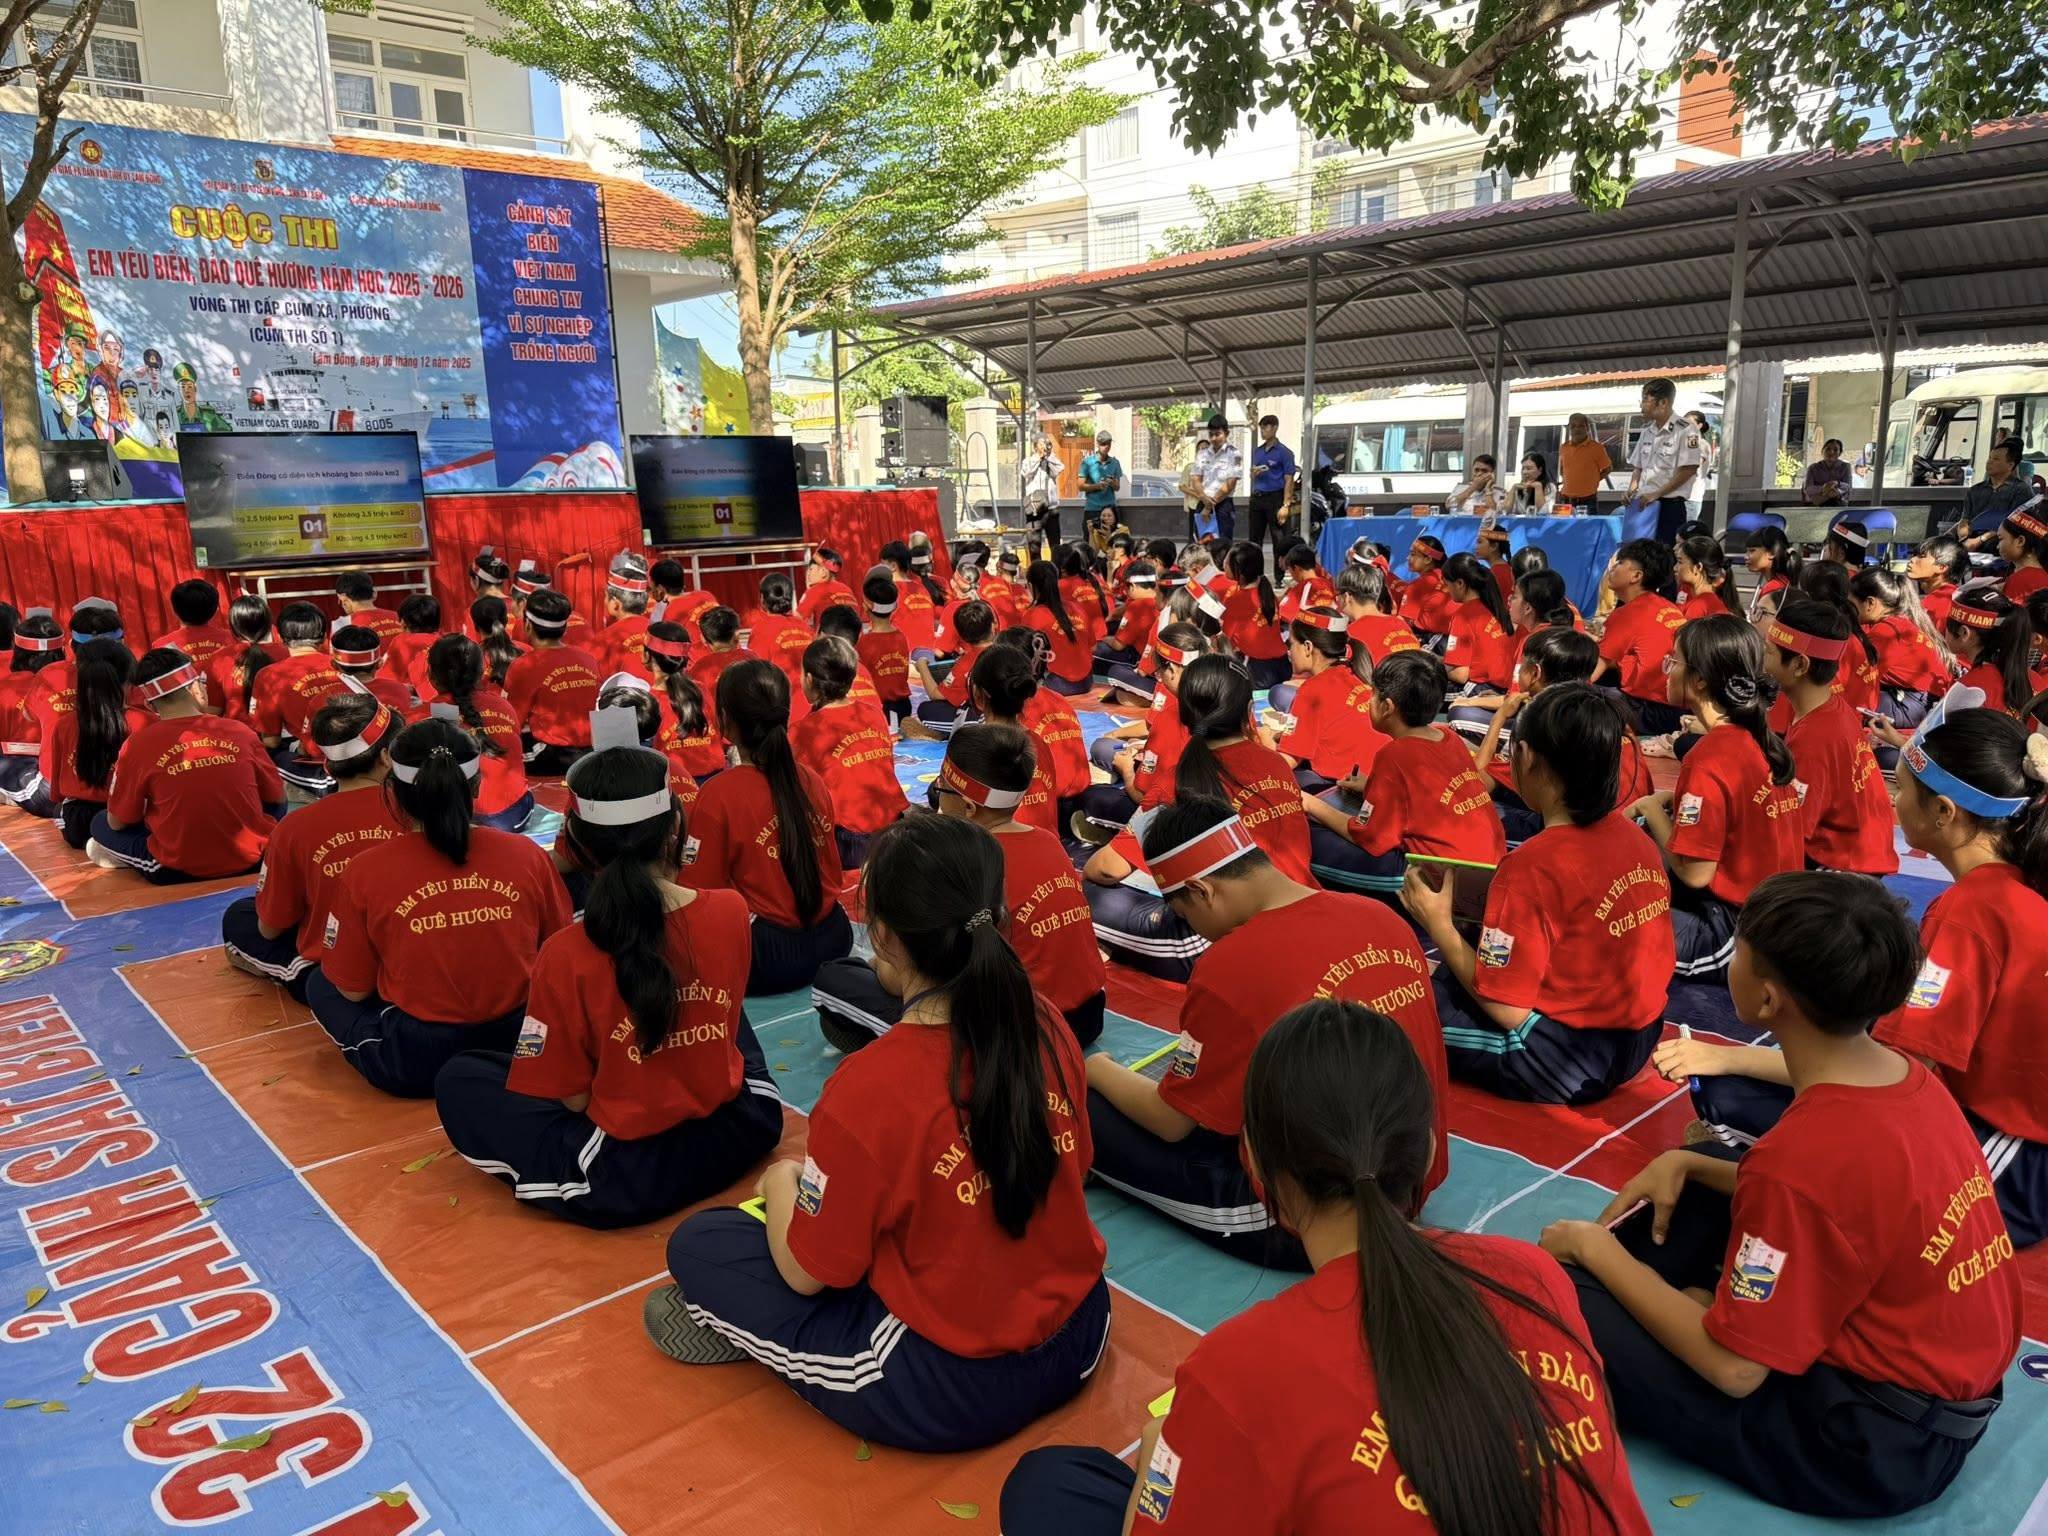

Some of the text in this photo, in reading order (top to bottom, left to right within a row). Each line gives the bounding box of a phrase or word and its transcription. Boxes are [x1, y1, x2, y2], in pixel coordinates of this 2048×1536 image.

[169, 203, 339, 250] CUỘC THI
[507, 199, 572, 227] CẢNH SÁT
[527, 228, 559, 253] BIỂN
[87, 248, 115, 278] EM
[118, 246, 149, 280] YÊU
[153, 245, 197, 285] BIỂN,
[199, 250, 231, 285] ĐẢO
[234, 256, 265, 289] QUÊ
[267, 261, 318, 292] HƯƠNG
[320, 263, 353, 292] NĂM
[357, 268, 385, 298] HỌC
[388, 271, 420, 297] 2025
[432, 275, 464, 299] 2026
[513, 257, 577, 282] VIỆT NAM
[189, 294, 391, 321] VÒNG THI CẤP CỤM XÃ, PHƯỜNG
[513, 288, 583, 309] CHUNG TAY
[250, 325, 344, 346] (CỤM THI SỐ 1)
[508, 312, 593, 339] VÌ SỰ NGHIỆP
[313, 351, 331, 366] Lâm
[421, 356, 430, 367] 12
[452, 356, 472, 369] 2025
[556, 340, 597, 363] NGƯỜI
[234, 418, 393, 431] VIETNAM COAST GUARD 8005
[384, 469, 400, 477] km2
[278, 514, 294, 522] km2
[303, 520, 323, 533] 01
[715, 507, 730, 519] 01
[1967, 613, 1994, 627] NAM
[156, 736, 240, 768] EM YÊU BIỂN ĐẢO
[167, 754, 237, 775] QUÊ HƯƠNG
[841, 752, 864, 768] QUÊ
[1258, 774, 1281, 791] BIỂN
[1752, 784, 1772, 805] EM
[1242, 800, 1301, 828] QUÊ HƯƠNG
[1453, 797, 1477, 815] QUÊ
[312, 824, 393, 865] EM YÊU BIỂN
[755, 826, 772, 846] EM
[395, 872, 520, 919] EM YÊU BIỂN ĐẢO
[1016, 871, 1076, 924] EM YÊU BIỂN
[1594, 862, 1652, 922] EM YÊU BIỂN
[410, 905, 513, 935] QUÊ HƯƠNG
[1030, 912, 1061, 938] QUÊ
[1608, 895, 1670, 938] QUÊ HƯƠNG
[1322, 942, 1422, 988] YÊU BIỂN ĐẢO
[1371, 979, 1425, 1014] HƯƠNG
[610, 1016, 635, 1044] EM
[932, 1142, 967, 1180] EM
[1920, 1223, 1955, 1267] EM
[1943, 1186, 1972, 1230] YÊU
[0, 1164, 281, 1382] CẢNH
[1947, 1248, 1985, 1293] QUÊ
[1538, 1351, 1596, 1402] ĐẢO
[123, 1346, 373, 1527] 32
